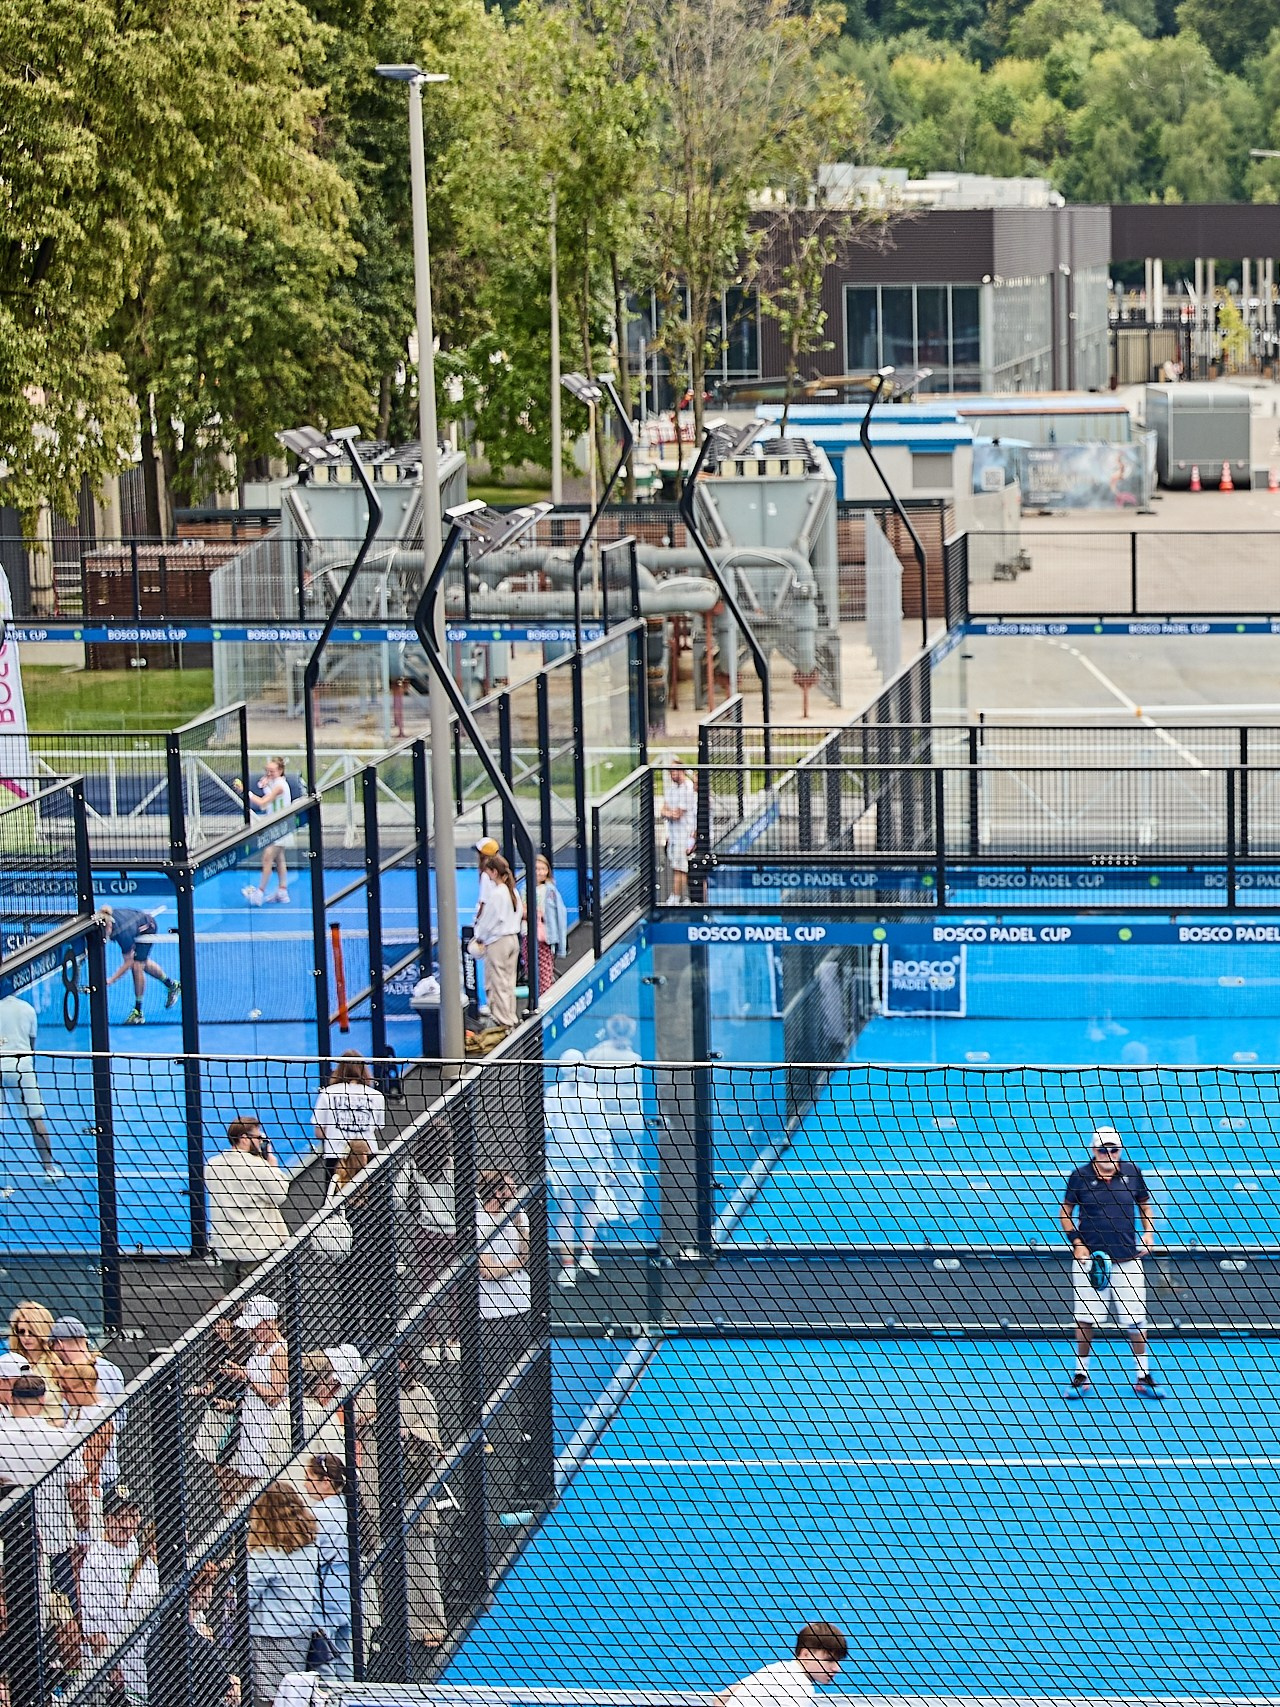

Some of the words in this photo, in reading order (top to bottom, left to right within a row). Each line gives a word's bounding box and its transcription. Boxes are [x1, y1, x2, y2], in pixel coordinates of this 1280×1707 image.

[5, 630, 27, 640] ADEL
[29, 630, 47, 640] CUP
[108, 630, 138, 640] BOSCO
[140, 630, 167, 640] PADEL
[169, 630, 187, 640] CUP
[247, 630, 278, 640] BOSCO
[279, 630, 307, 640] PADEL
[387, 630, 418, 640] BOSCO
[448, 630, 467, 640] CUP
[527, 630, 558, 640] BOSCO
[752, 873, 800, 886] BOSCO
[804, 873, 846, 886] PADEL
[850, 873, 878, 886] CUP
[978, 874, 1026, 887] BOSCO
[1030, 874, 1072, 887] PADEL
[1077, 874, 1104, 887] CUP
[110, 880, 137, 893] CUP
[688, 926, 741, 941] BOSCO
[744, 926, 791, 941] PADEL
[794, 926, 826, 941] CUP
[933, 927, 987, 942] BOSCO
[990, 927, 1037, 942] PADEL
[1040, 927, 1071, 942] CUP
[1179, 927, 1233, 941] BOSCO
[892, 960, 955, 977] BOSCO
[892, 978, 928, 991] PADEL
